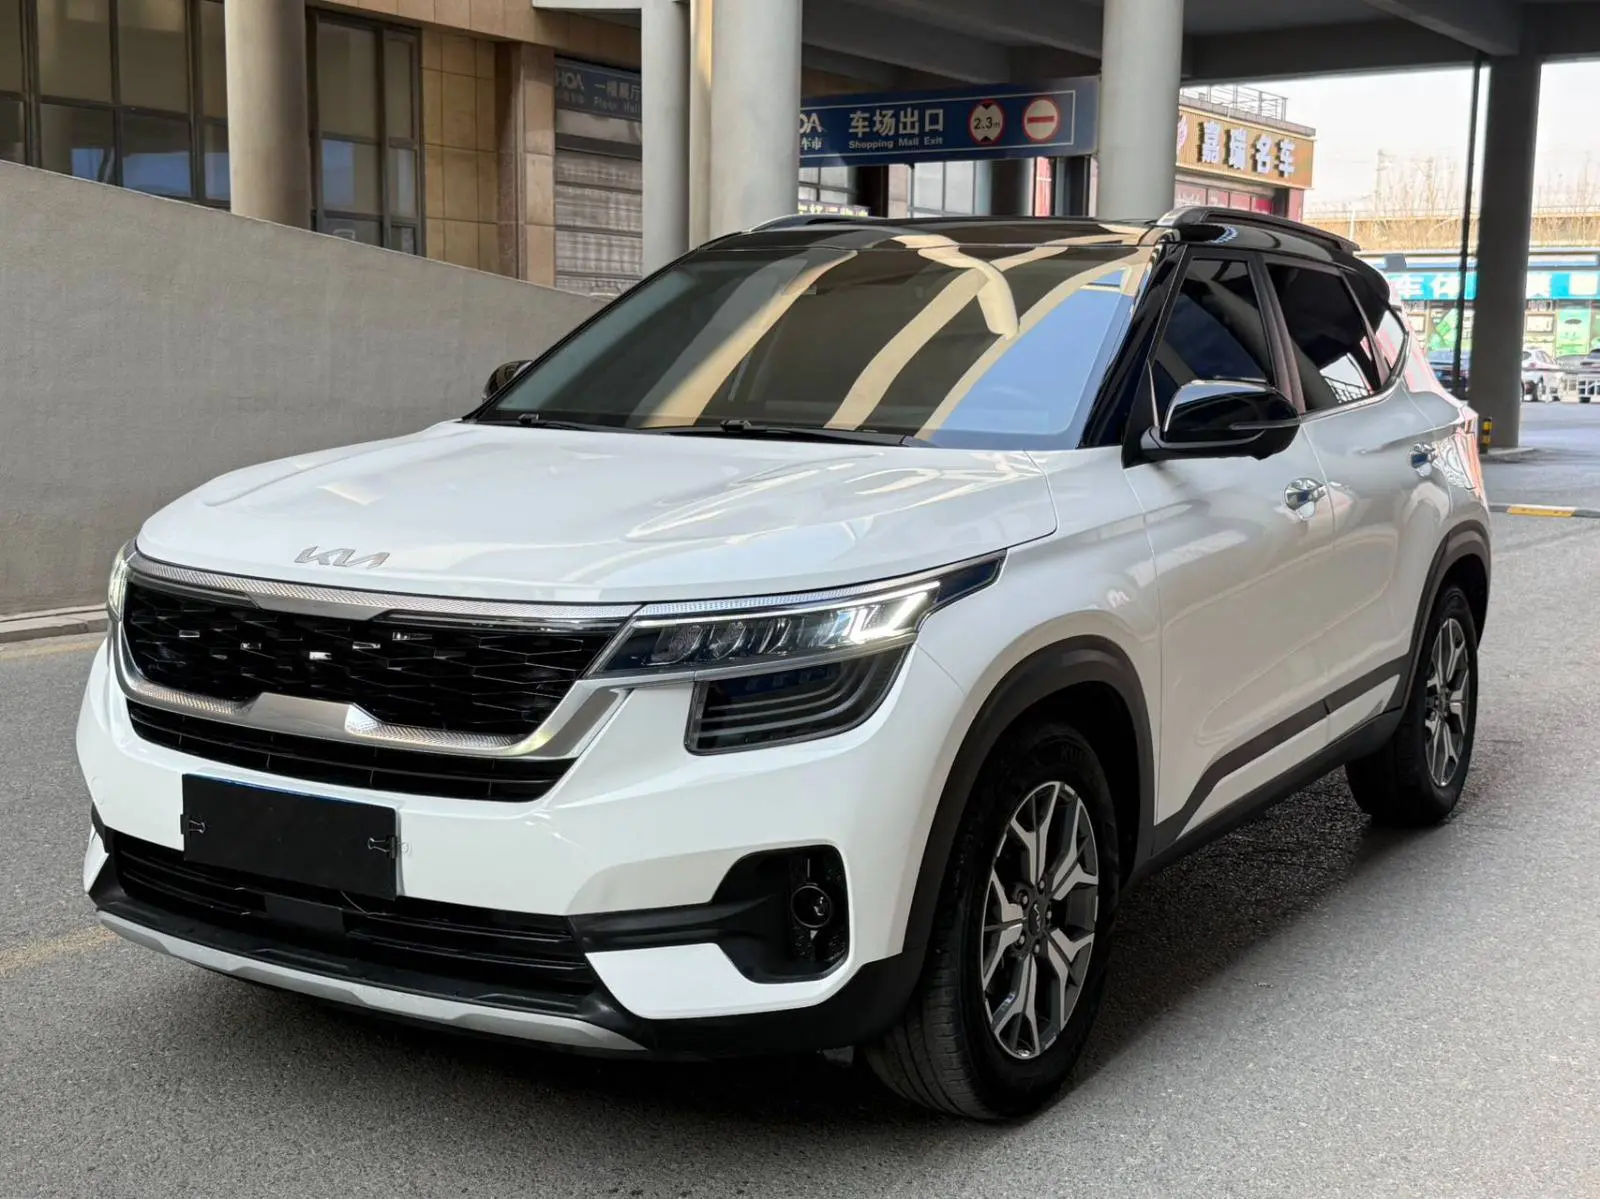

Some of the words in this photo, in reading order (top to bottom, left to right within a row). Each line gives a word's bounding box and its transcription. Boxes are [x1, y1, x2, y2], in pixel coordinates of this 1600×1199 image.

[848, 107, 944, 138] 车场出口
[848, 139, 895, 150] Shopping
[898, 137, 919, 147] Mall
[924, 136, 943, 146] Exit
[1200, 121, 1296, 178] 嘉瑞名车
[294, 545, 391, 570] KIA
